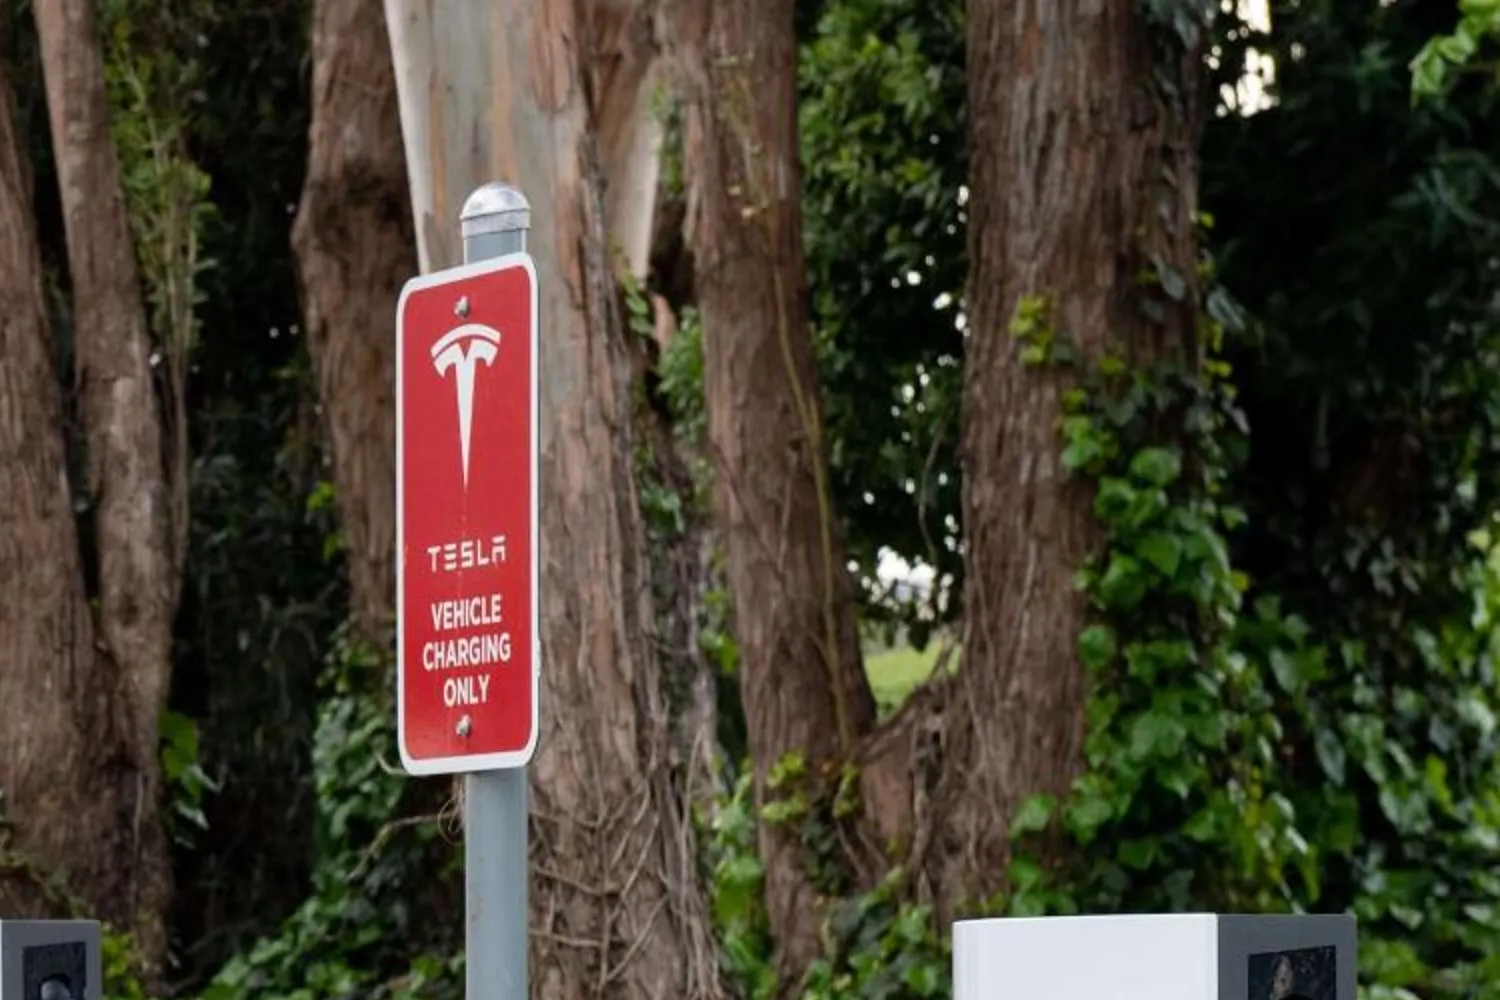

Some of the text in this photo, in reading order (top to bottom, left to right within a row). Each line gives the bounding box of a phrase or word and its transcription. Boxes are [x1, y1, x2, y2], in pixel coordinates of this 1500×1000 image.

[427, 535, 506, 572] TESLA
[431, 594, 502, 631] VEHICLE
[422, 633, 512, 671] CHARGING
[443, 675, 490, 707] ONLY
